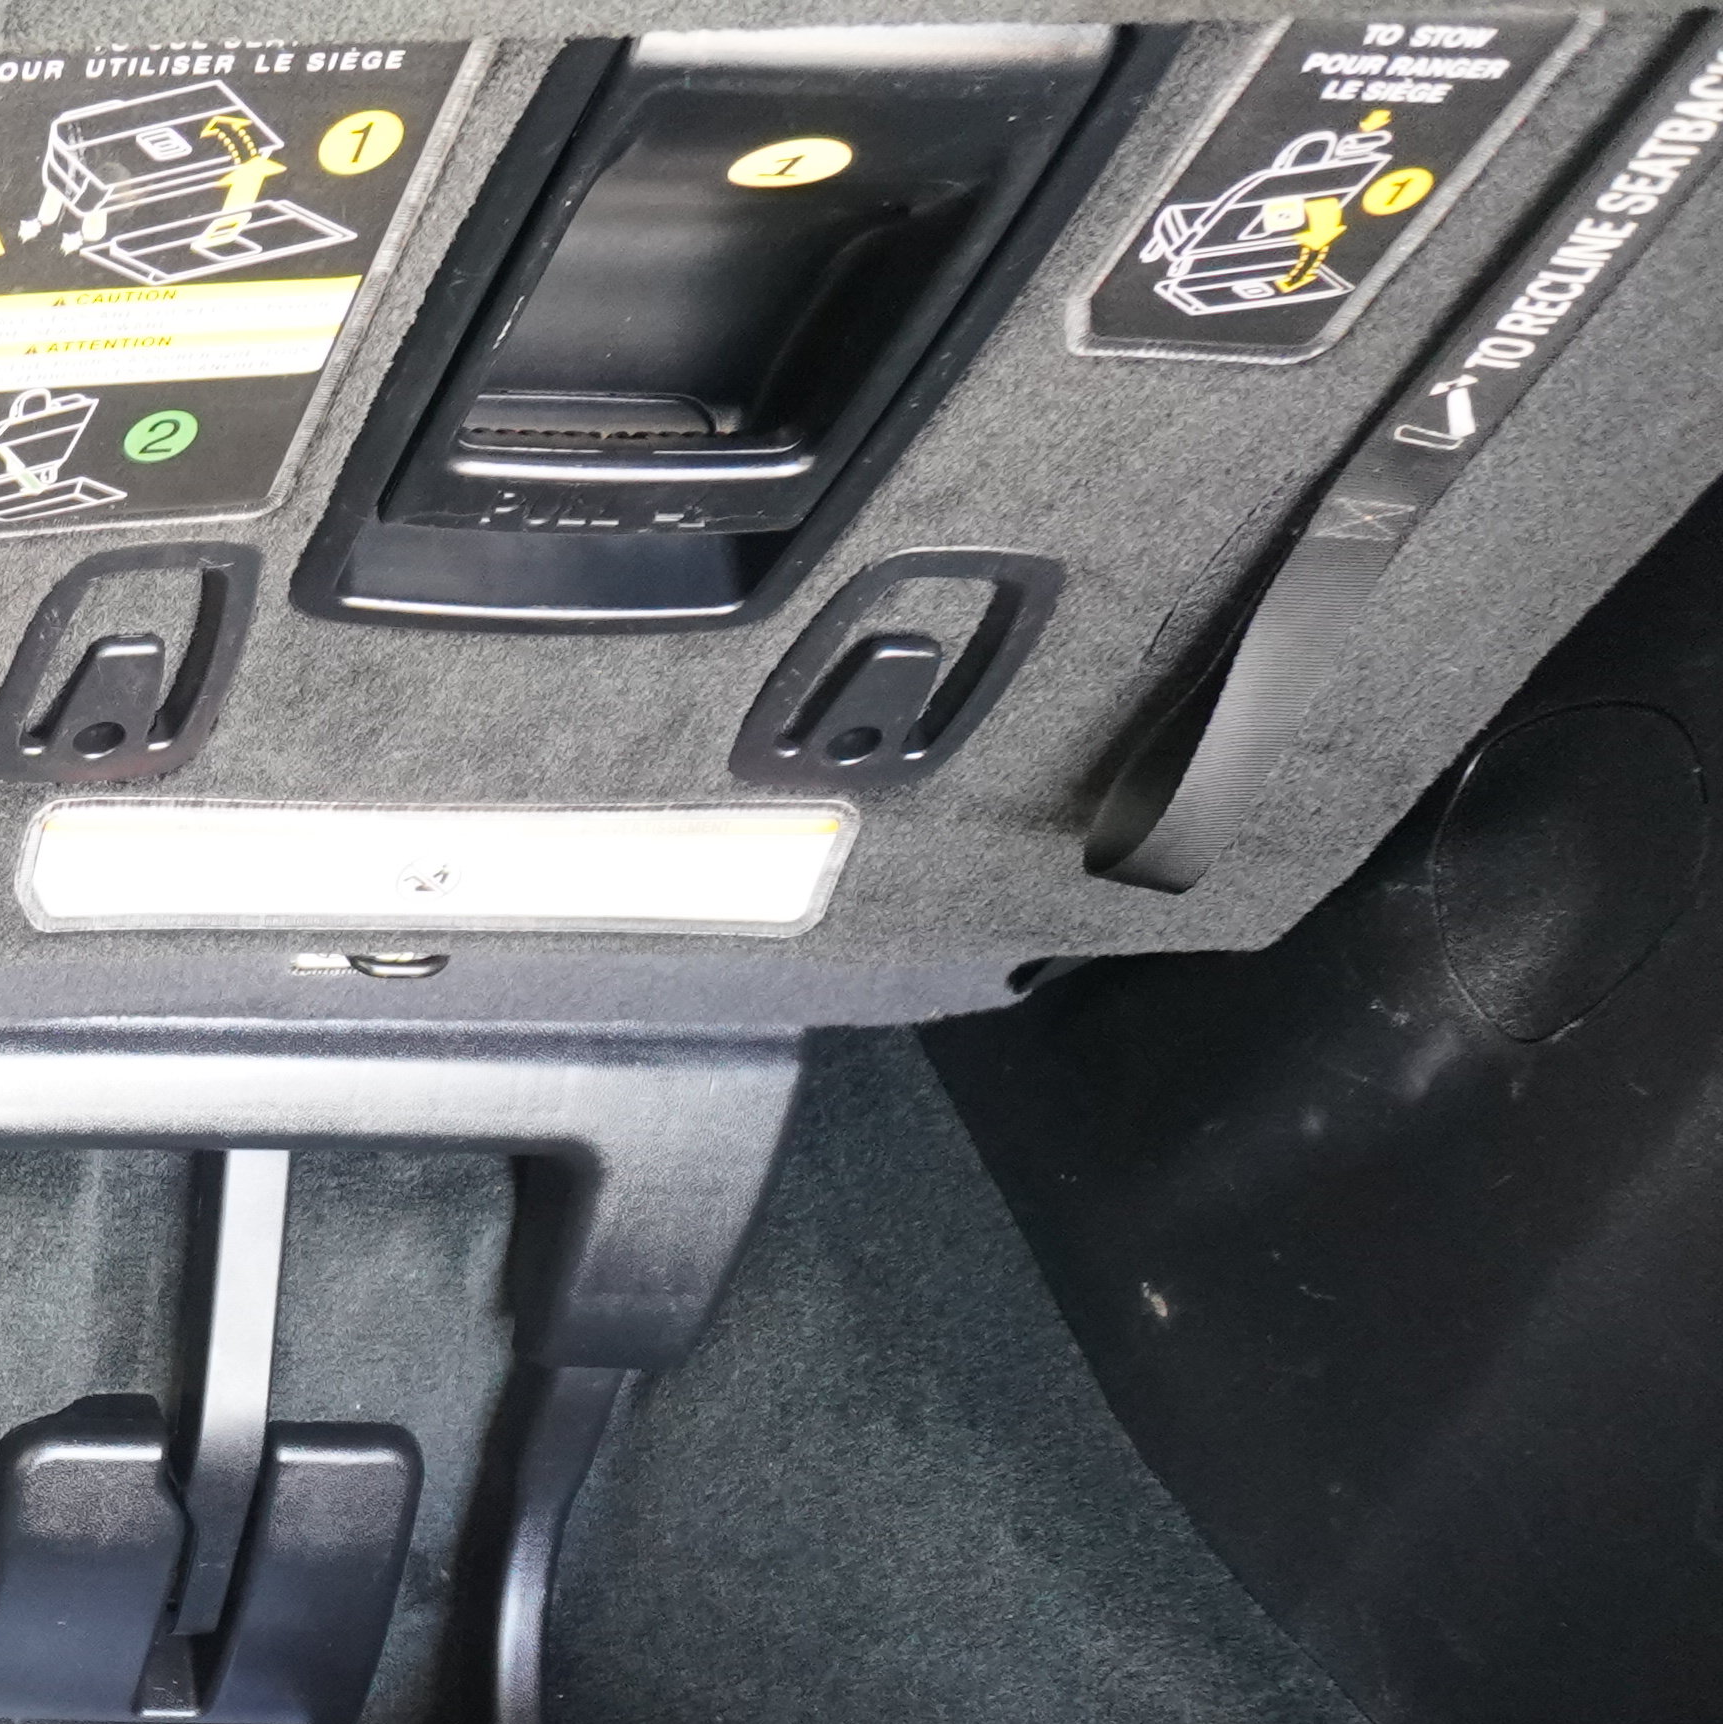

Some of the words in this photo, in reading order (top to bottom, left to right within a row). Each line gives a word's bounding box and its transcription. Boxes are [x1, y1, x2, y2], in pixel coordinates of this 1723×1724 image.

[1361, 22, 1405, 47] TO
[1408, 23, 1500, 49] STOW
[85, 53, 236, 80] UTILISER
[254, 51, 295, 75] LE
[305, 46, 407, 73] SIÈGE
[1300, 51, 1389, 77] POUR
[1384, 54, 1512, 80] RANGER
[1319, 78, 1365, 101] LE
[1361, 76, 1455, 104] SIÈGE
[349, 121, 377, 165] 1
[75, 289, 178, 305] CAUTION
[1463, 332, 1538, 371] TO
[1517, 213, 1640, 341] RECLINE
[47, 335, 173, 353] ATTENTION
[137, 419, 184, 455] 2
